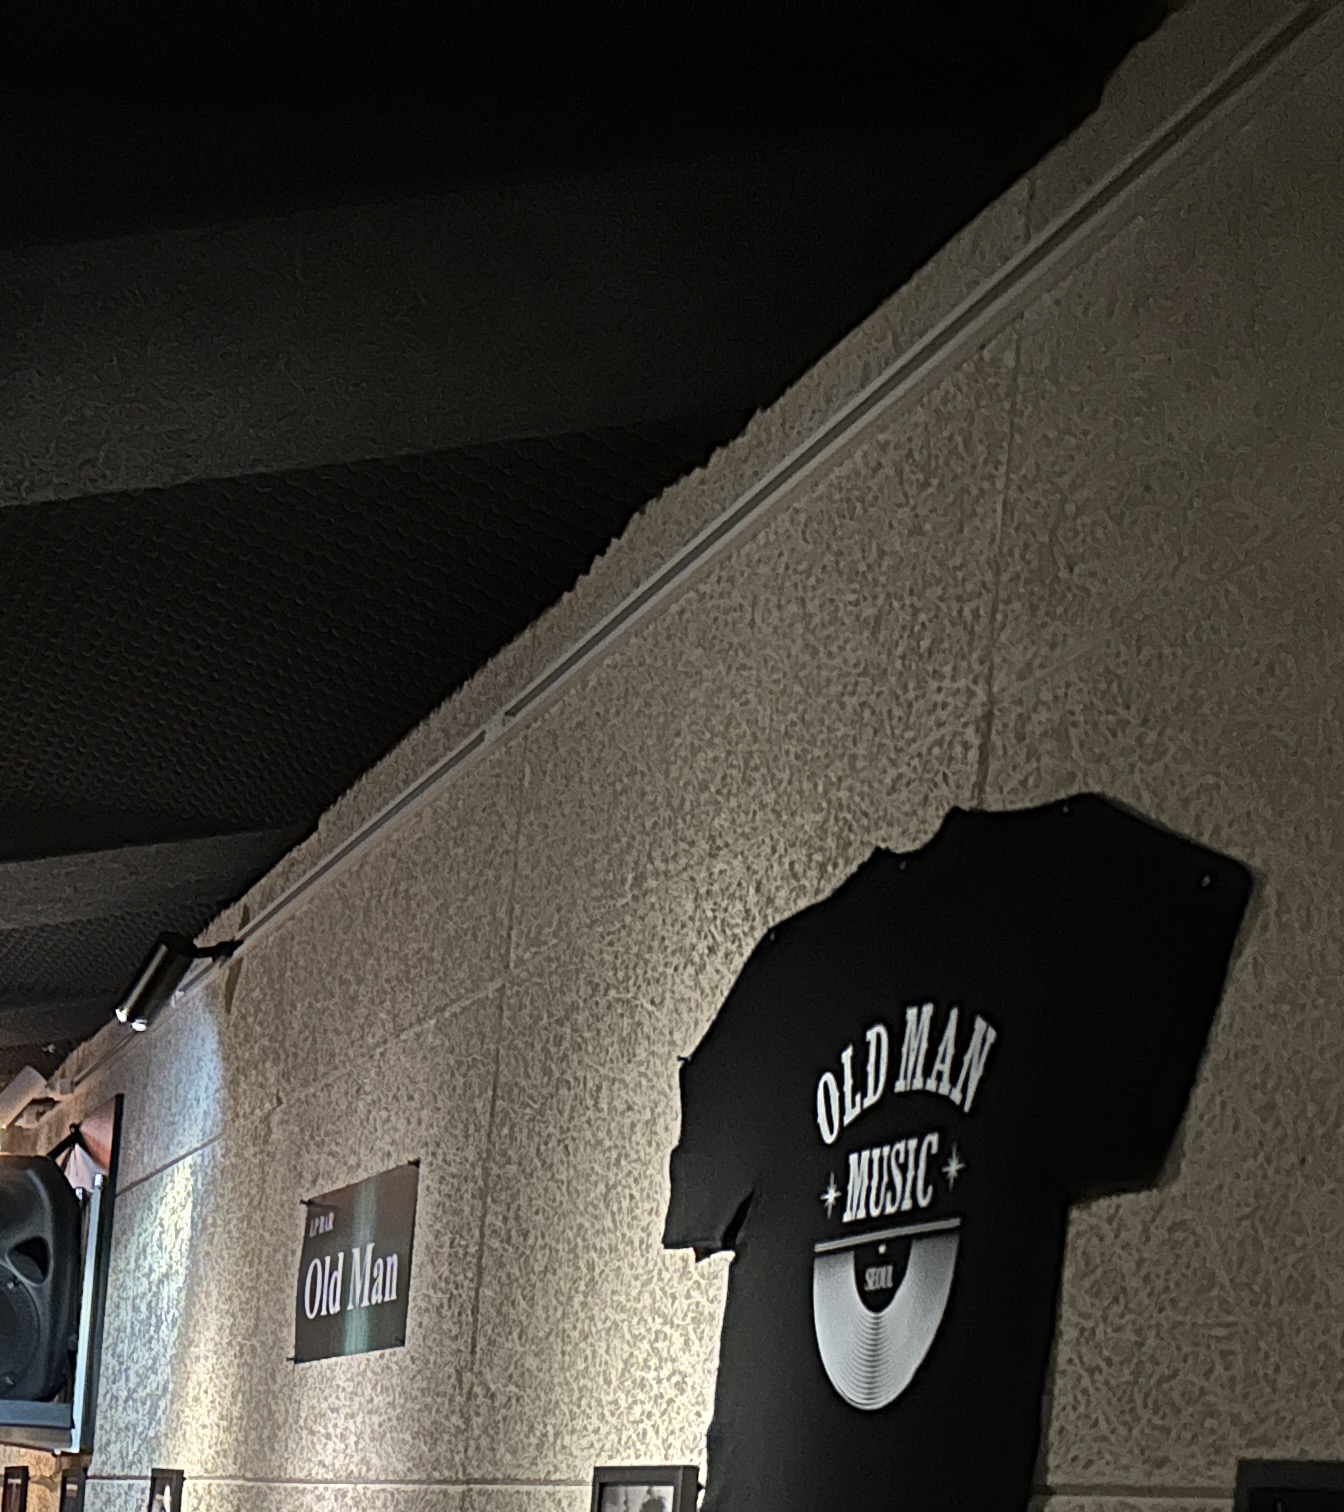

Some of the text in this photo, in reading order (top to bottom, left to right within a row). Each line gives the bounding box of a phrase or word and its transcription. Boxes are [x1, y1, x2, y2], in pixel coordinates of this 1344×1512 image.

[816, 1003, 997, 1144] OLD MAN
[842, 1132, 940, 1223] MUSIC
[304, 1242, 399, 1319] Old Man
[864, 1265, 894, 1291] SEOUL
